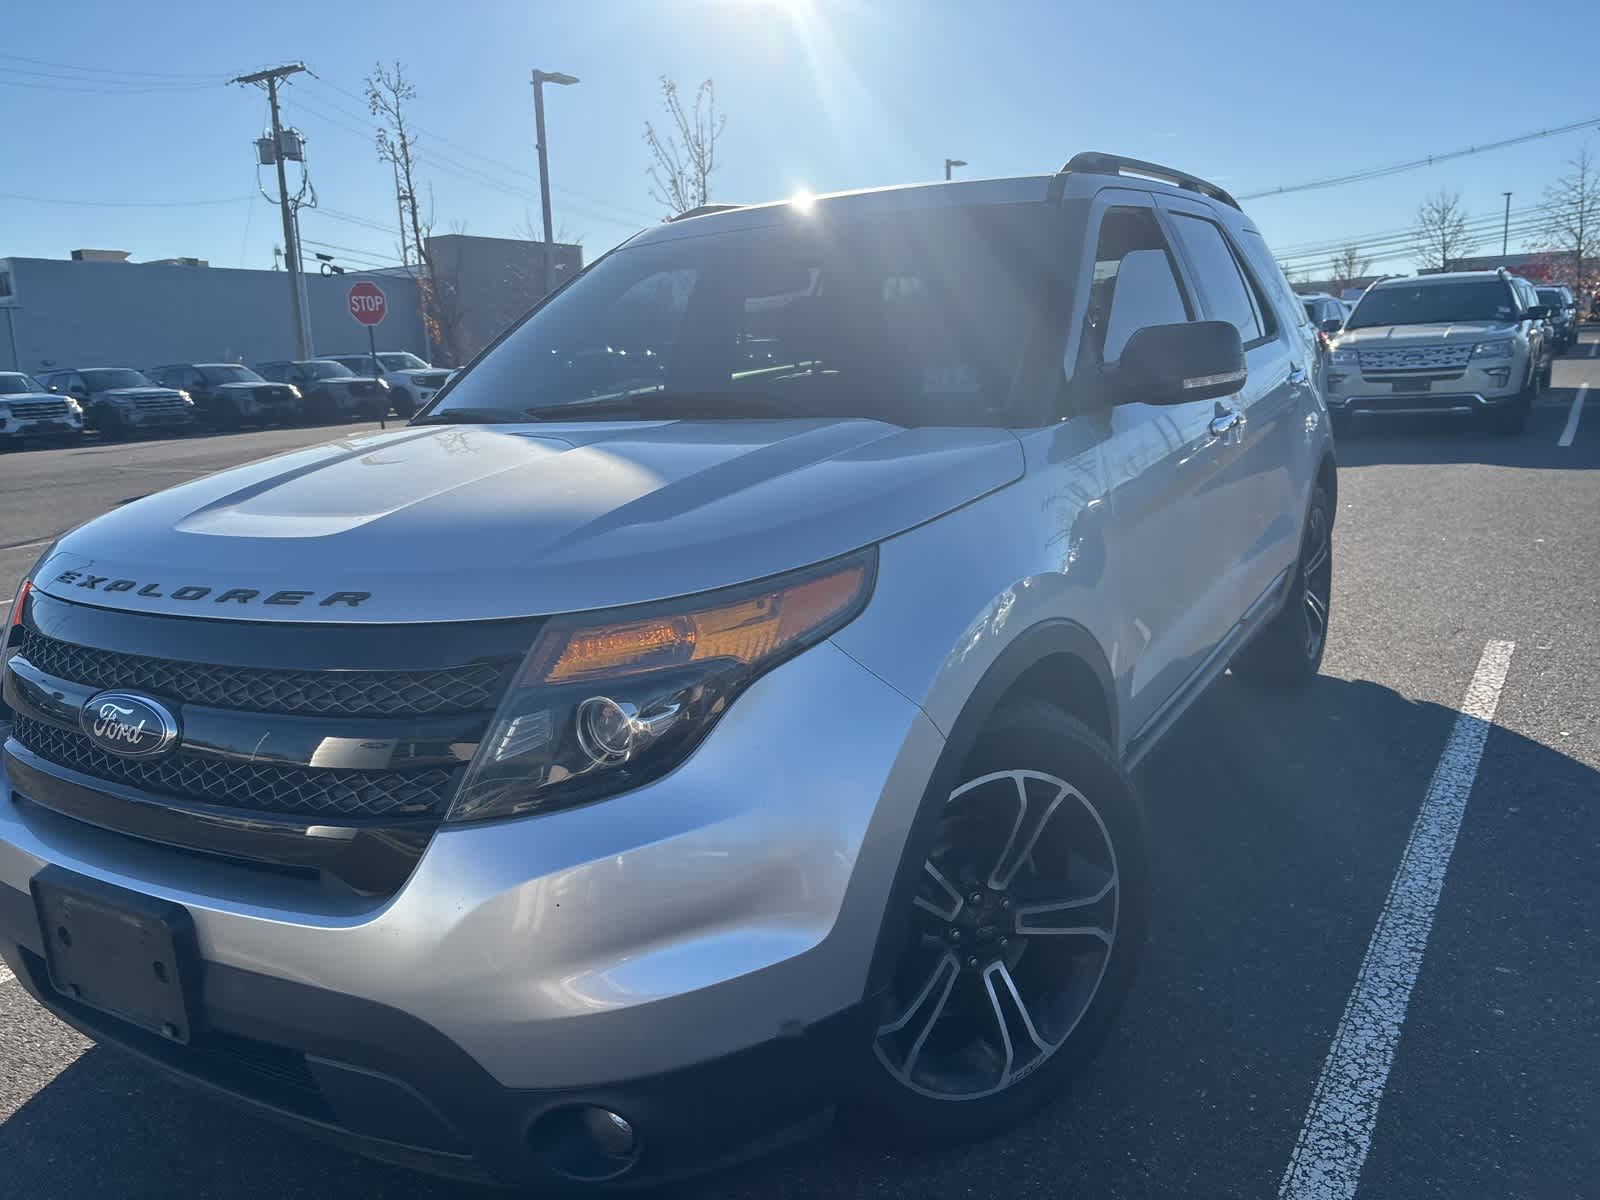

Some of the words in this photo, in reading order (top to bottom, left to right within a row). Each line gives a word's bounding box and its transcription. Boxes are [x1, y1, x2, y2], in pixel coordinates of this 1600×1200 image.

[351, 295, 384, 312] STOP
[56, 570, 372, 607] EXPLORER
[93, 703, 146, 744] Ford
